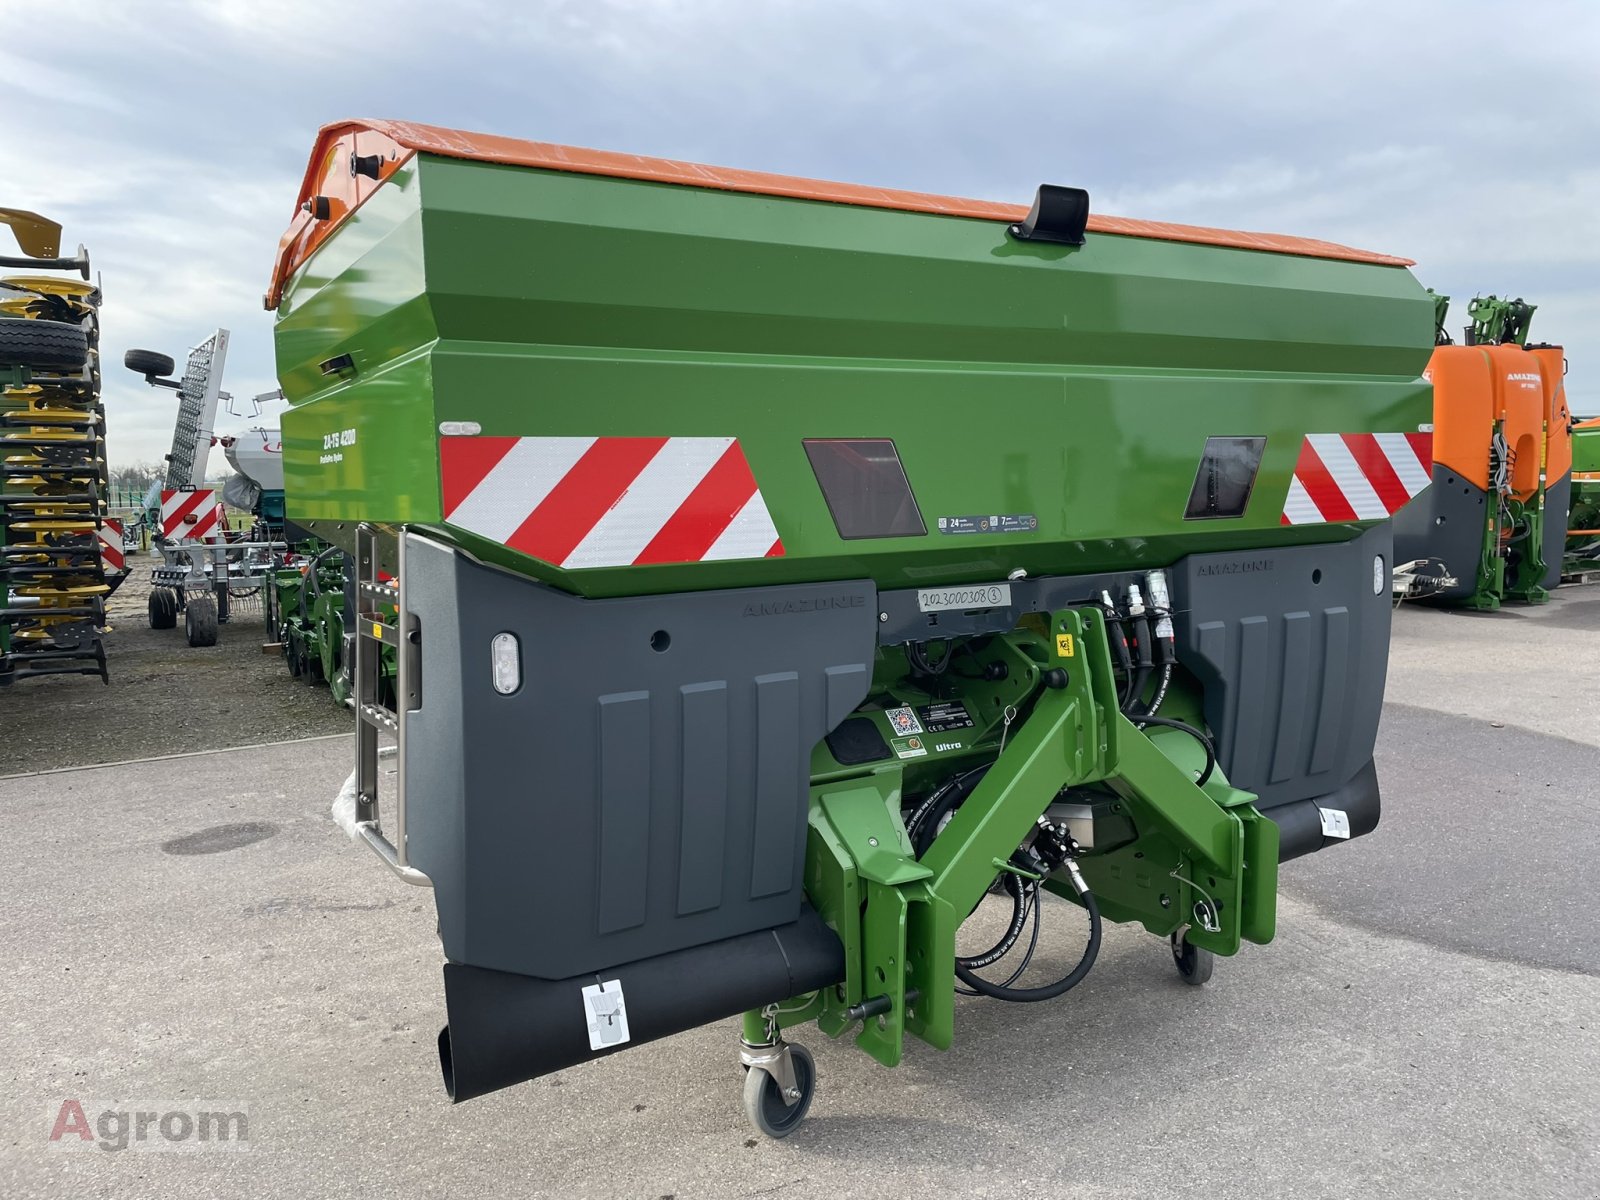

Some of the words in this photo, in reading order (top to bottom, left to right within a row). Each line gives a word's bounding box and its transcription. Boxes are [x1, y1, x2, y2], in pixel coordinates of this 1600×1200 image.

[324, 432, 339, 449] ZA-TS
[340, 428, 355, 446] 4200
[950, 518, 959, 528] 24
[1001, 516, 1006, 526] 7
[1197, 559, 1274, 577] AMAZONE
[742, 596, 865, 617] AMAZONE
[922, 588, 986, 607] 2023000308
[935, 742, 962, 752] Ultra
